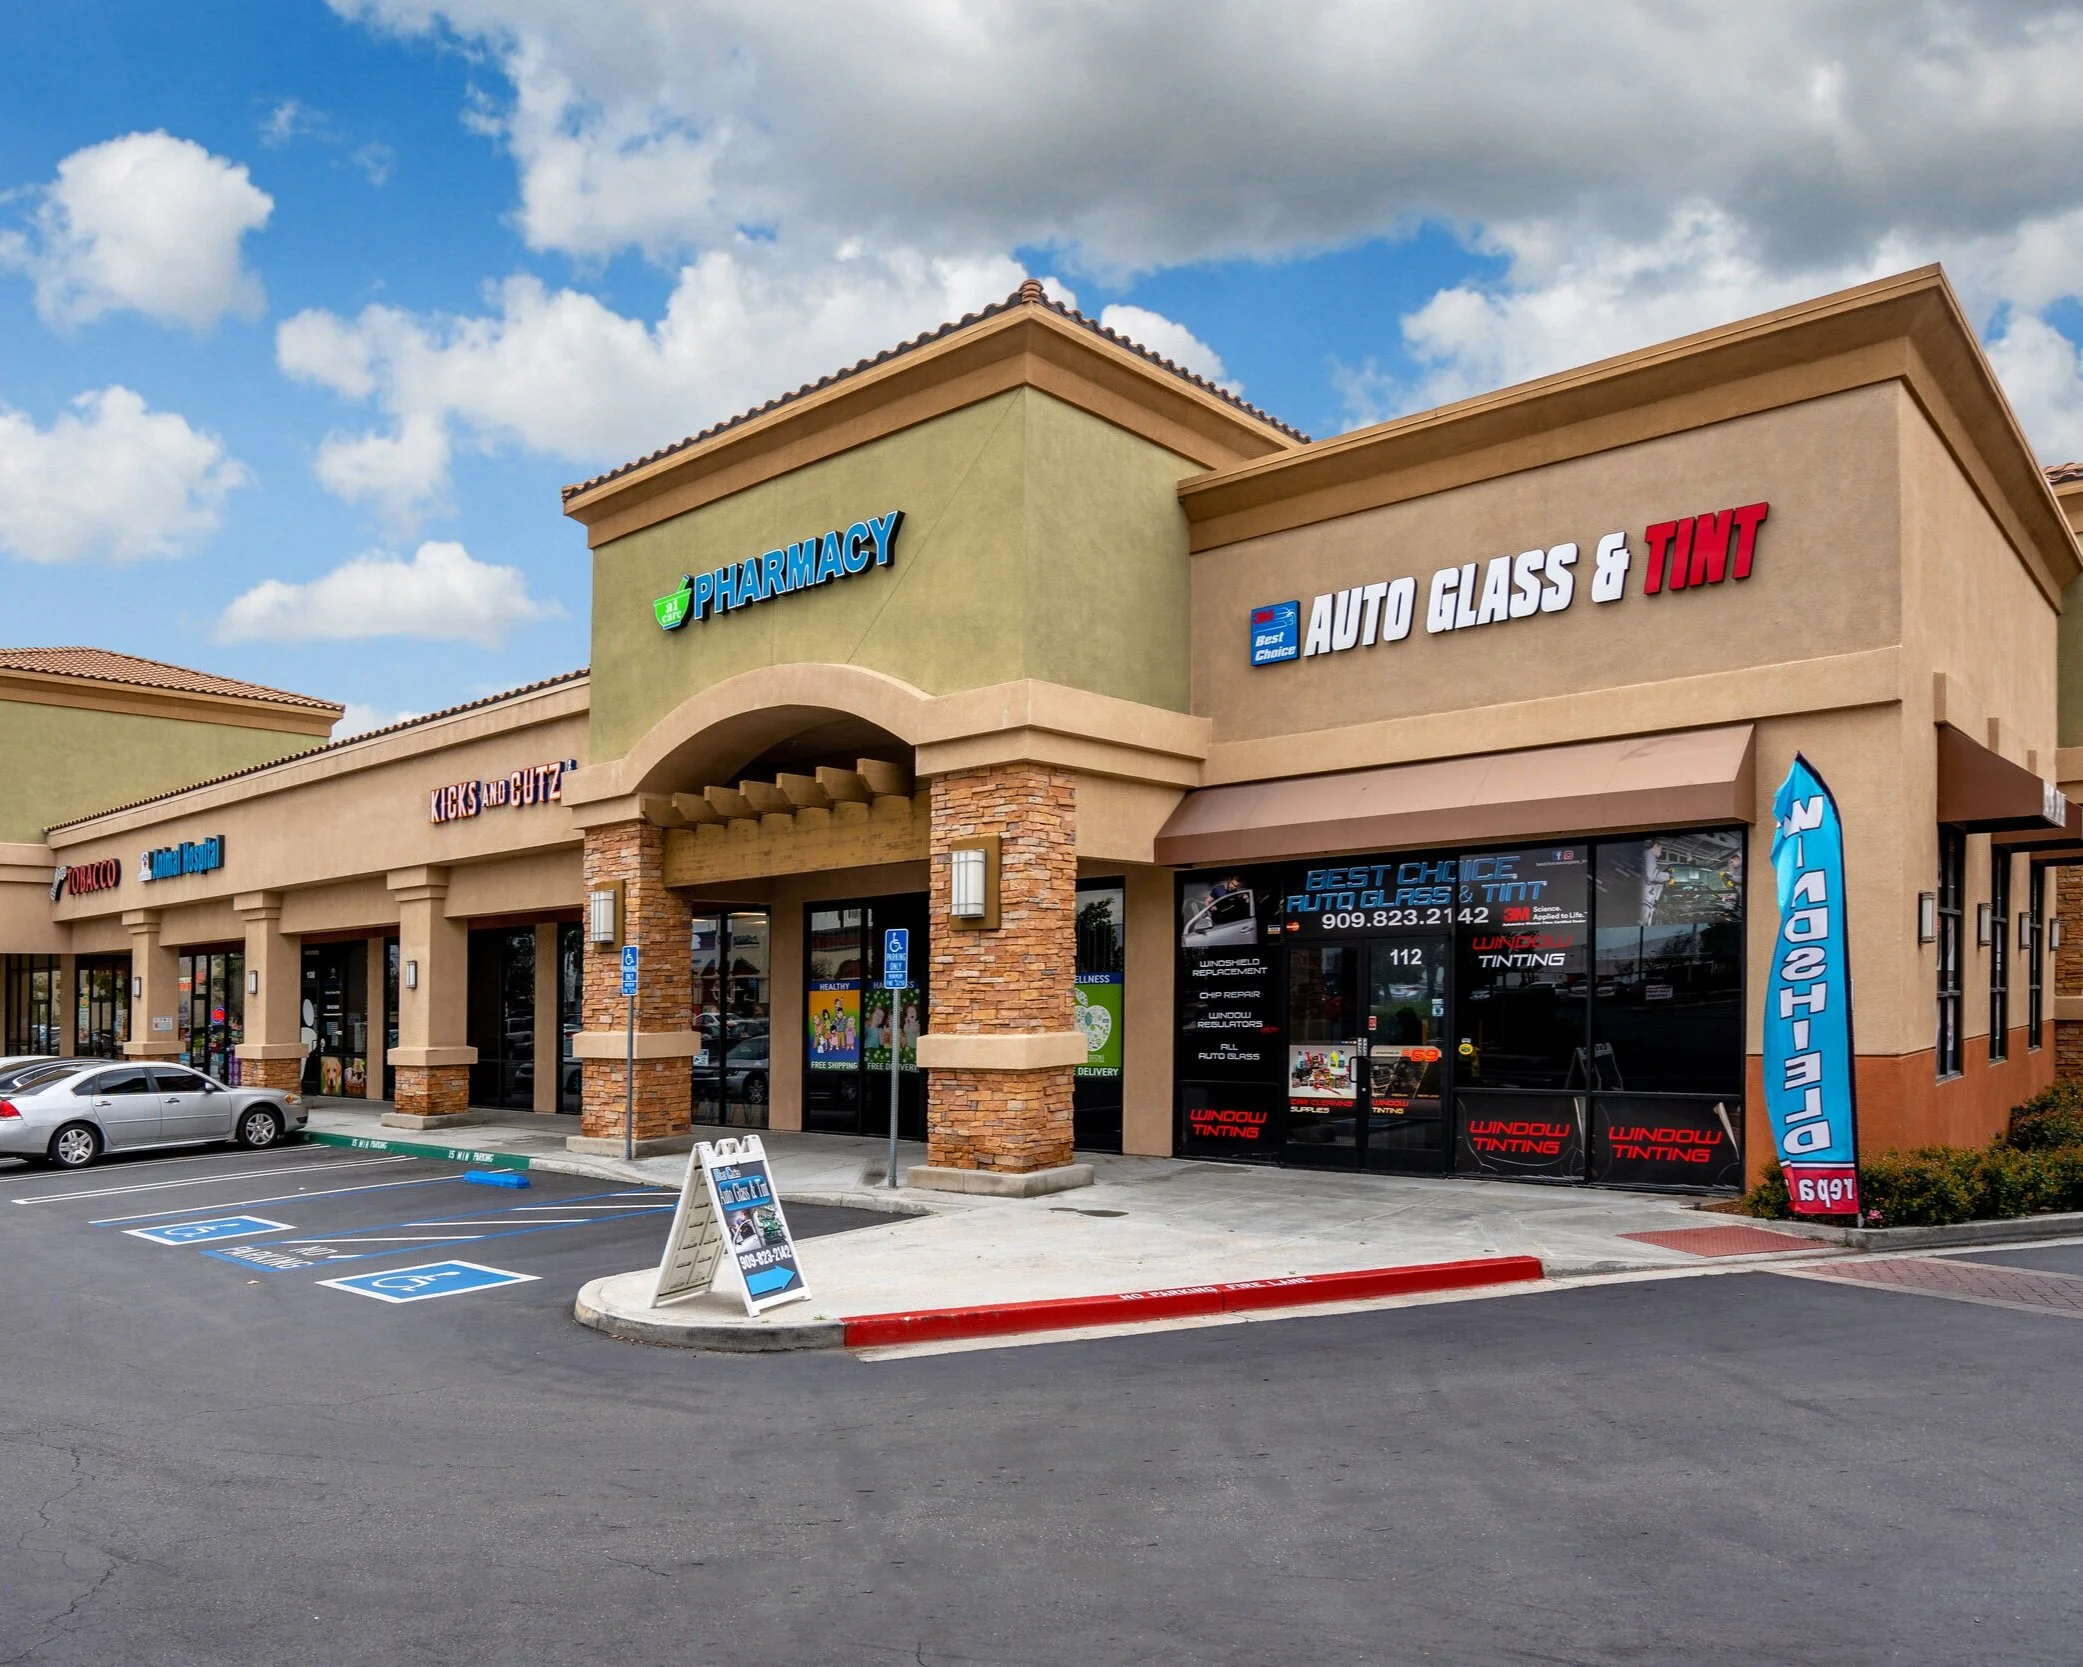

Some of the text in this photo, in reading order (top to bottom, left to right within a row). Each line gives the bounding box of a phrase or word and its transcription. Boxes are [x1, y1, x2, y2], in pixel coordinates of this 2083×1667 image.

[694, 510, 902, 620] PHARMACY
[1303, 501, 1769, 657] AUTO GLASS & TINT
[662, 610, 682, 624] care
[1253, 609, 1274, 624] 3M
[1255, 631, 1285, 647] Best
[1255, 645, 1297, 661] Choice
[430, 781, 479, 823] KICKS
[482, 780, 508, 808] AND
[151, 835, 225, 880] Animal Hospital
[66, 858, 120, 895] TOBACCO
[1306, 856, 1520, 891] BEST CHOICE
[1286, 881, 1547, 912] AUTO GLASS & TINT
[1322, 907, 1489, 929] 909.823.2142
[1503, 906, 1530, 922] 3M
[1533, 913, 1560, 921] Applied
[1472, 935, 1574, 950] WINDOW
[886, 953, 907, 961] PARKING
[1200, 958, 1260, 968] WINDSHIELD
[1390, 948, 1422, 965] 112
[1479, 953, 1566, 968] TINTING
[1074, 975, 1110, 984] ELLNESS
[1192, 967, 1268, 977] REPLACEMENT
[820, 983, 850, 991] HEALTHY
[1199, 990, 1260, 999] CHIP REPAIR
[1208, 1011, 1252, 1020] WINDOW
[1197, 1020, 1263, 1029] REGULATORS
[1220, 1043, 1238, 1051] ALL
[1198, 1052, 1225, 1060] AUTO
[811, 1061, 858, 1070] FREE SHIPPING
[867, 1062, 917, 1071] FREE DIVERY
[1078, 1067, 1119, 1076] DELIVERY
[1190, 1109, 1267, 1124] WINDOW
[1372, 1107, 1404, 1115] TINTING
[1193, 1124, 1259, 1139] TINTING
[1469, 1120, 1570, 1137] WINDOW
[1608, 1126, 1722, 1144] WINDOW
[351, 1139, 388, 1150] 15 MIN PARKING
[1473, 1137, 1560, 1154] TINTING
[448, 1150, 495, 1163] 15 MIN PARKING
[1612, 1144, 1712, 1163] TINTING
[720, 1178, 771, 1206] Auto Glass & Tint
[217, 1246, 315, 1269] PARKING
[289, 1246, 338, 1256] NO
[739, 1244, 792, 1270] 909-823-2142
[1119, 1277, 1313, 1301] NO PARKING FIRE LANE
